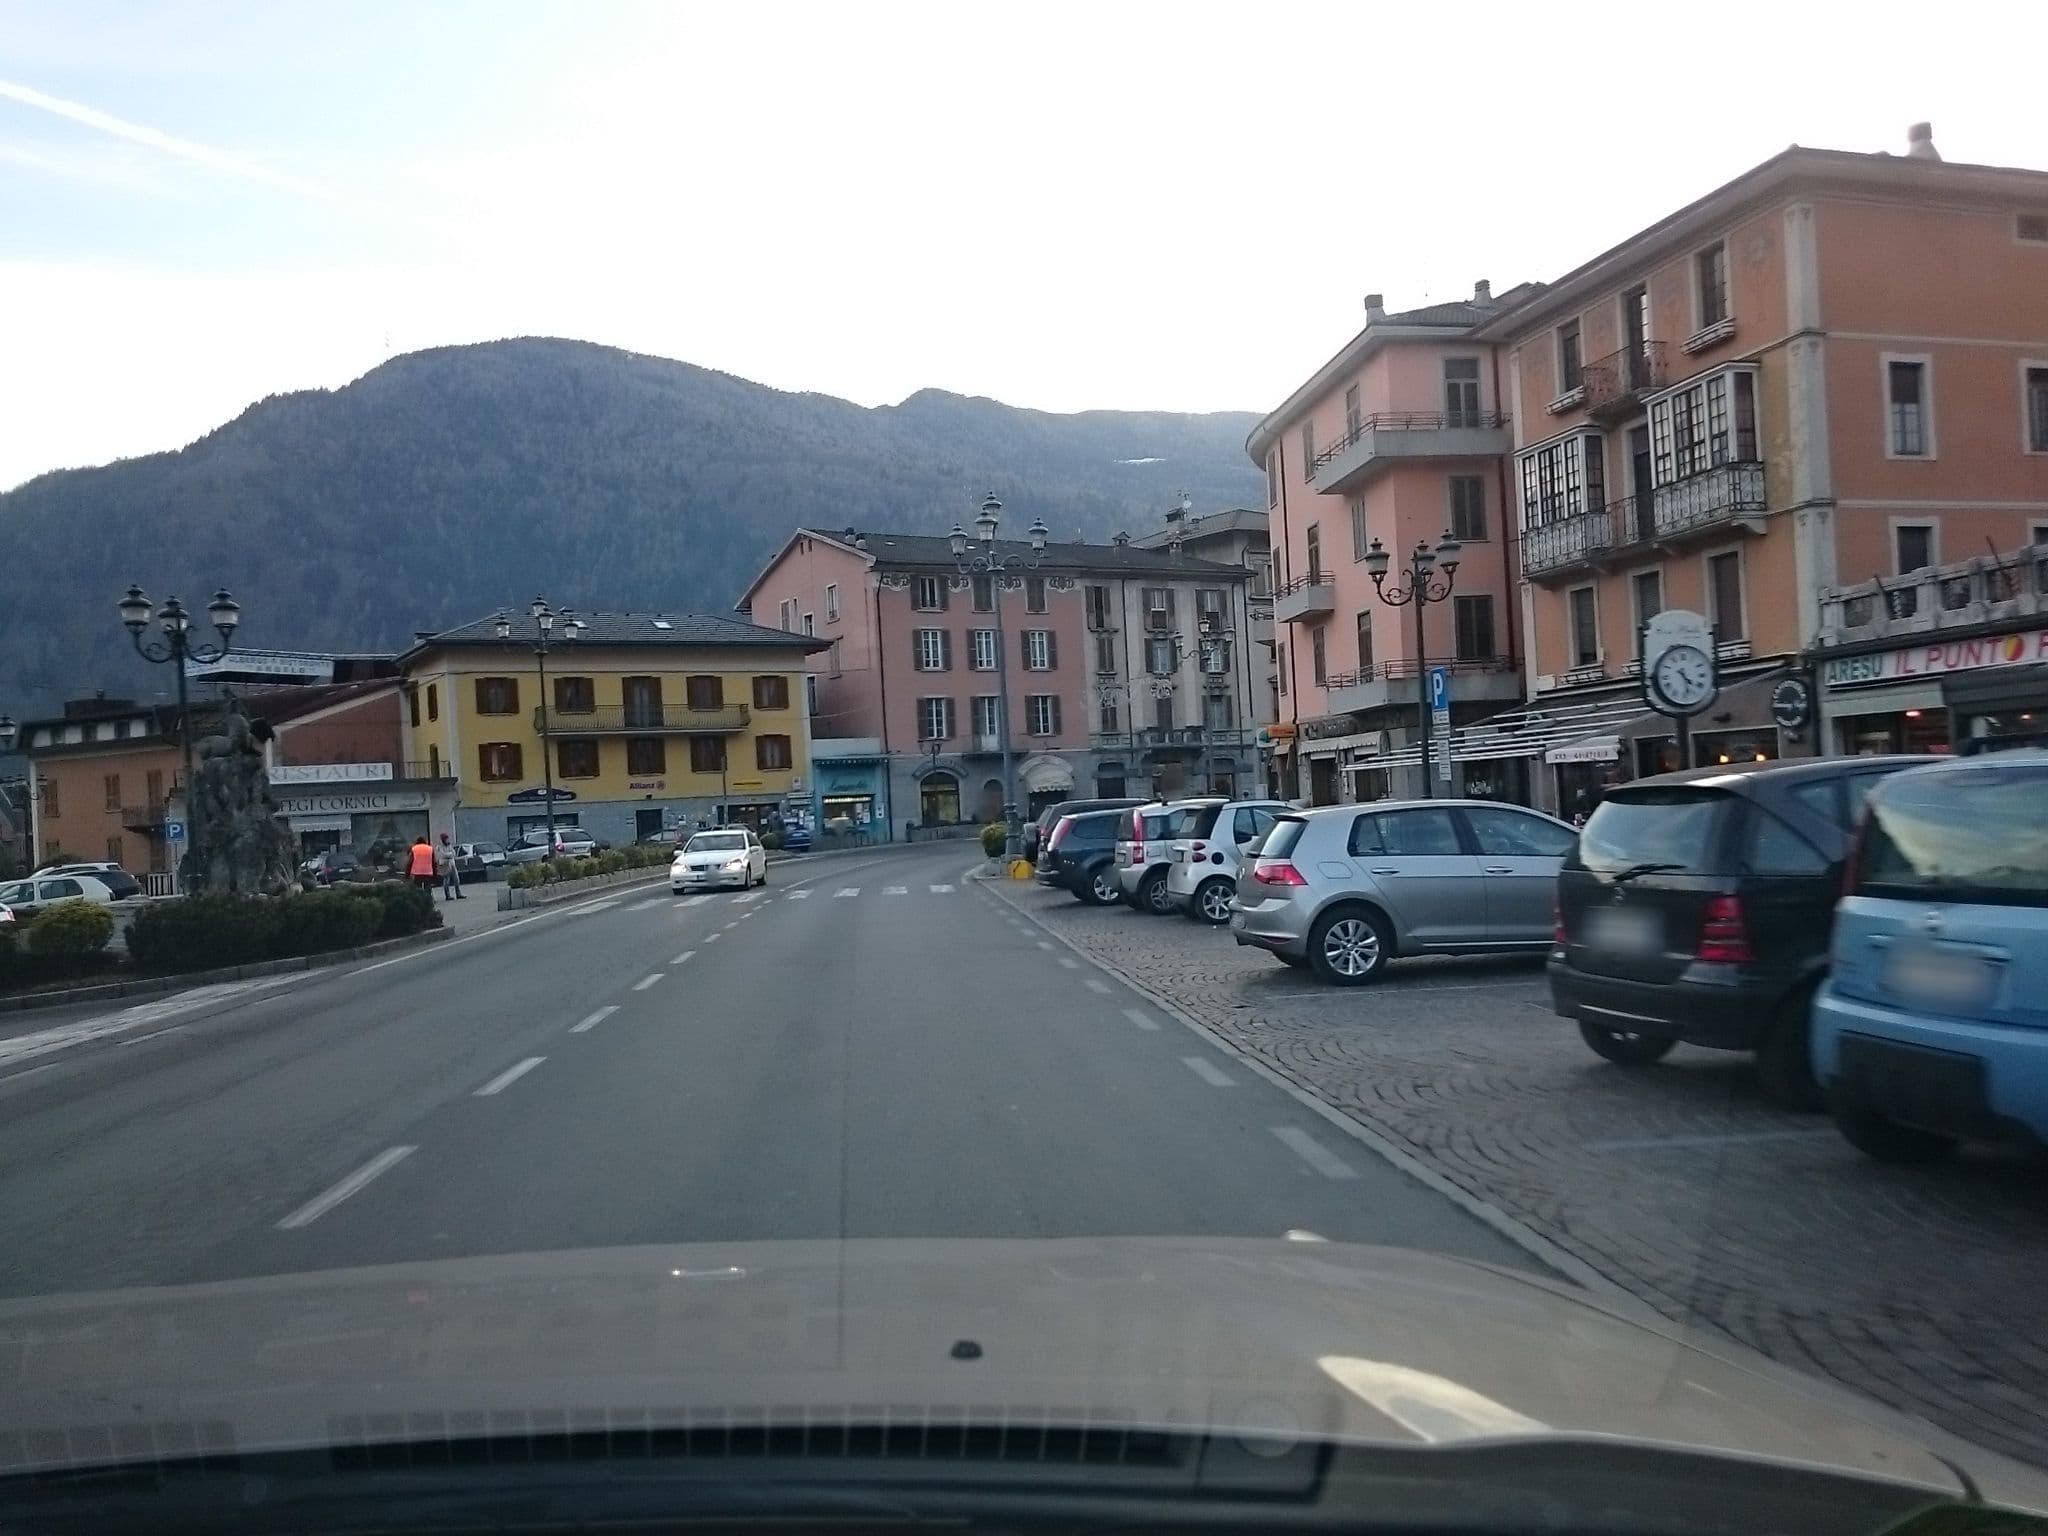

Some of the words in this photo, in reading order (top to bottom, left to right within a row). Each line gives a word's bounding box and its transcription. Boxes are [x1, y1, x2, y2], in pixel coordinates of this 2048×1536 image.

[1897, 650, 1915, 676] IL
[1433, 672, 1444, 706] P
[629, 782, 656, 790] Allianz
[319, 794, 388, 810] CORNICI
[170, 824, 181, 838] P
